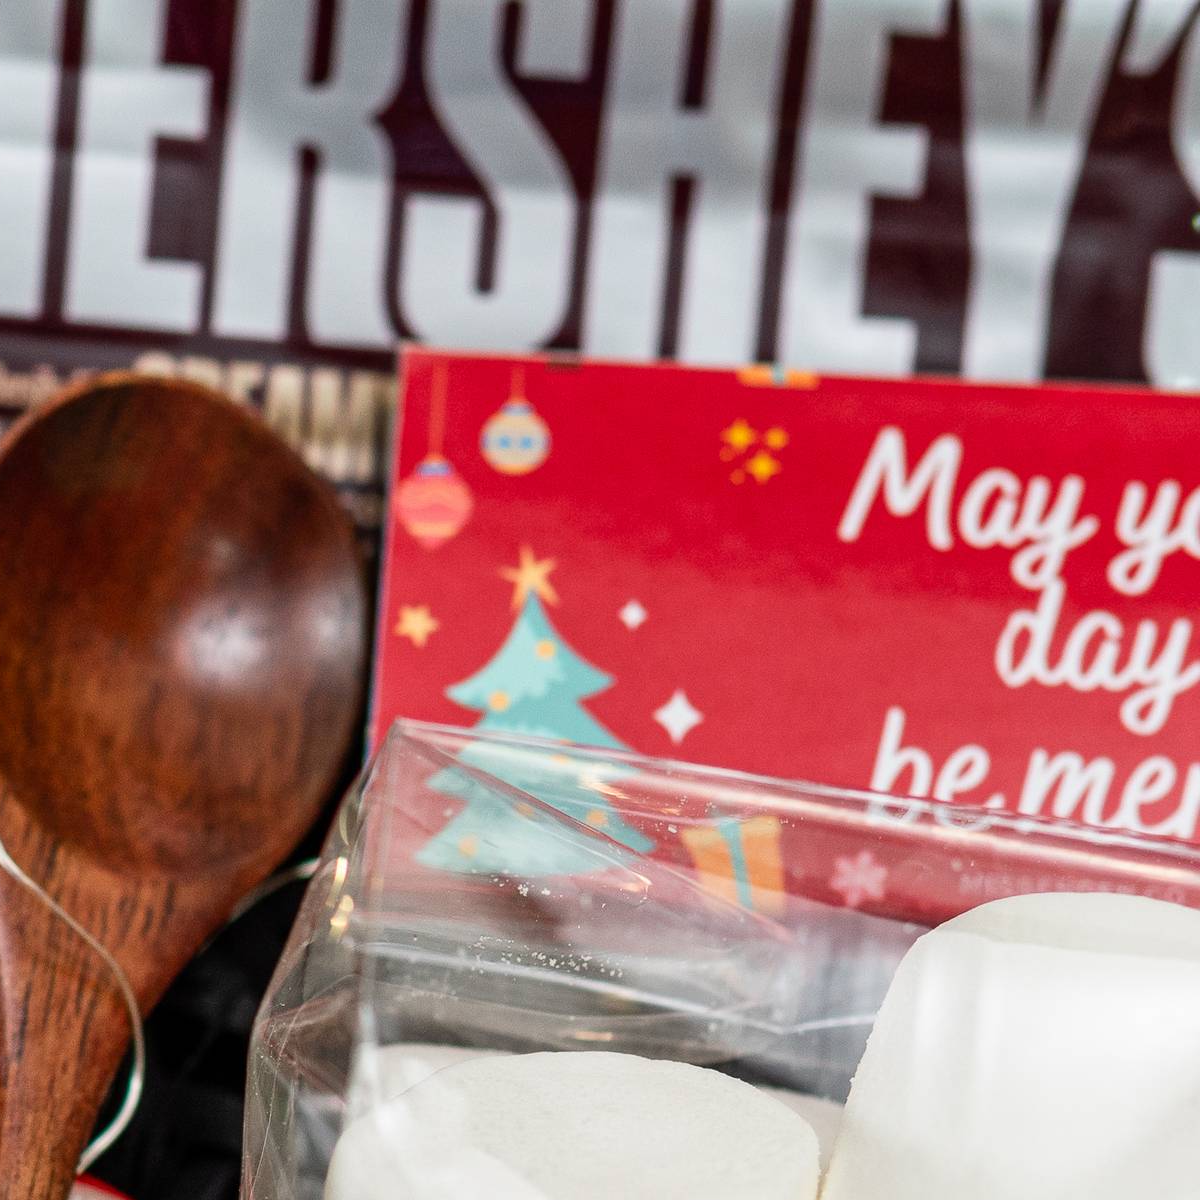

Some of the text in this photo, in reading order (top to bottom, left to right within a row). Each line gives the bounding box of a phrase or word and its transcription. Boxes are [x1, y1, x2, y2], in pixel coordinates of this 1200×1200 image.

[837, 424, 1100, 590] May
[995, 576, 1200, 736] day
[866, 706, 1006, 831] be
